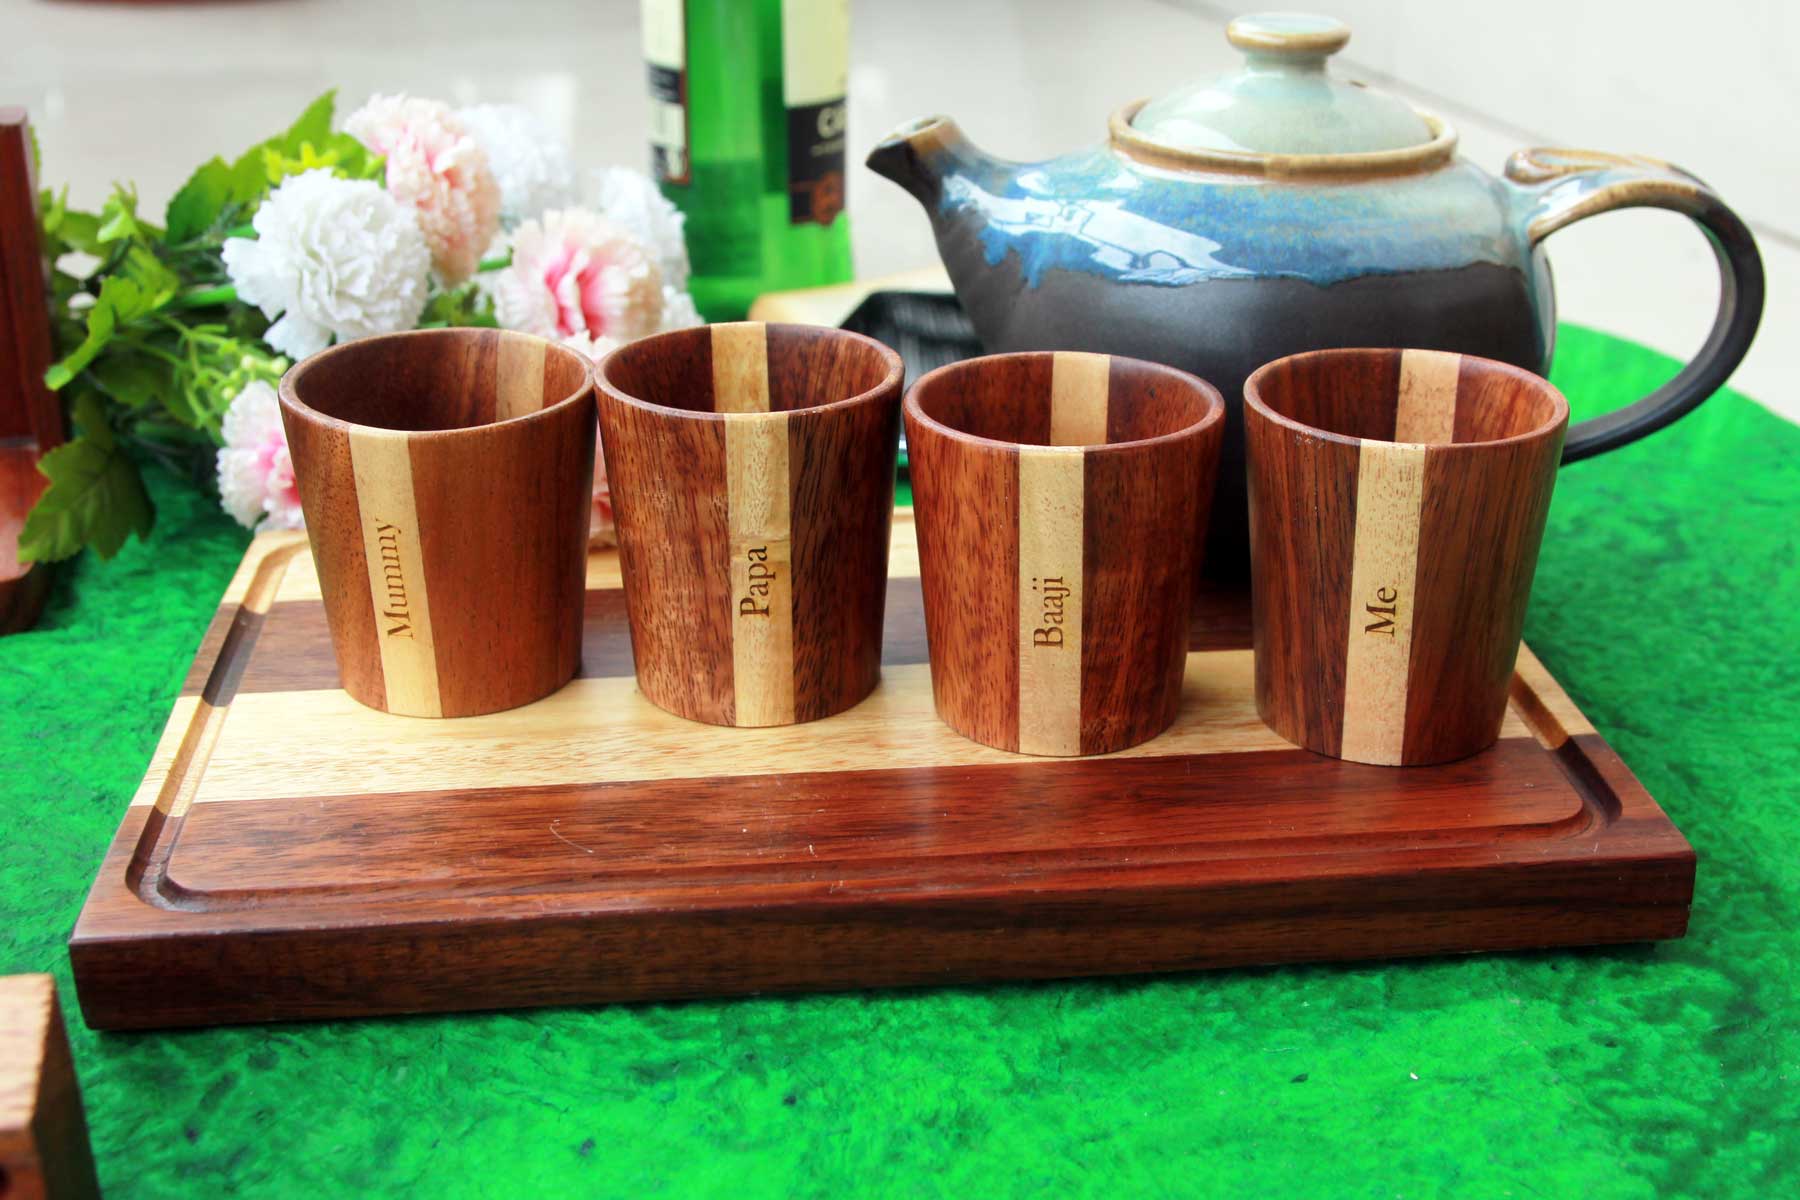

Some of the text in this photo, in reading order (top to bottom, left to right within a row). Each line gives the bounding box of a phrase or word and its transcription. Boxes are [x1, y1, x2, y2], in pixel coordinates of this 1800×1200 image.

[375, 517, 414, 640] Mummy
[739, 545, 776, 617] Papa
[1032, 576, 1070, 650] Baaji
[1364, 586, 1397, 638] Me
